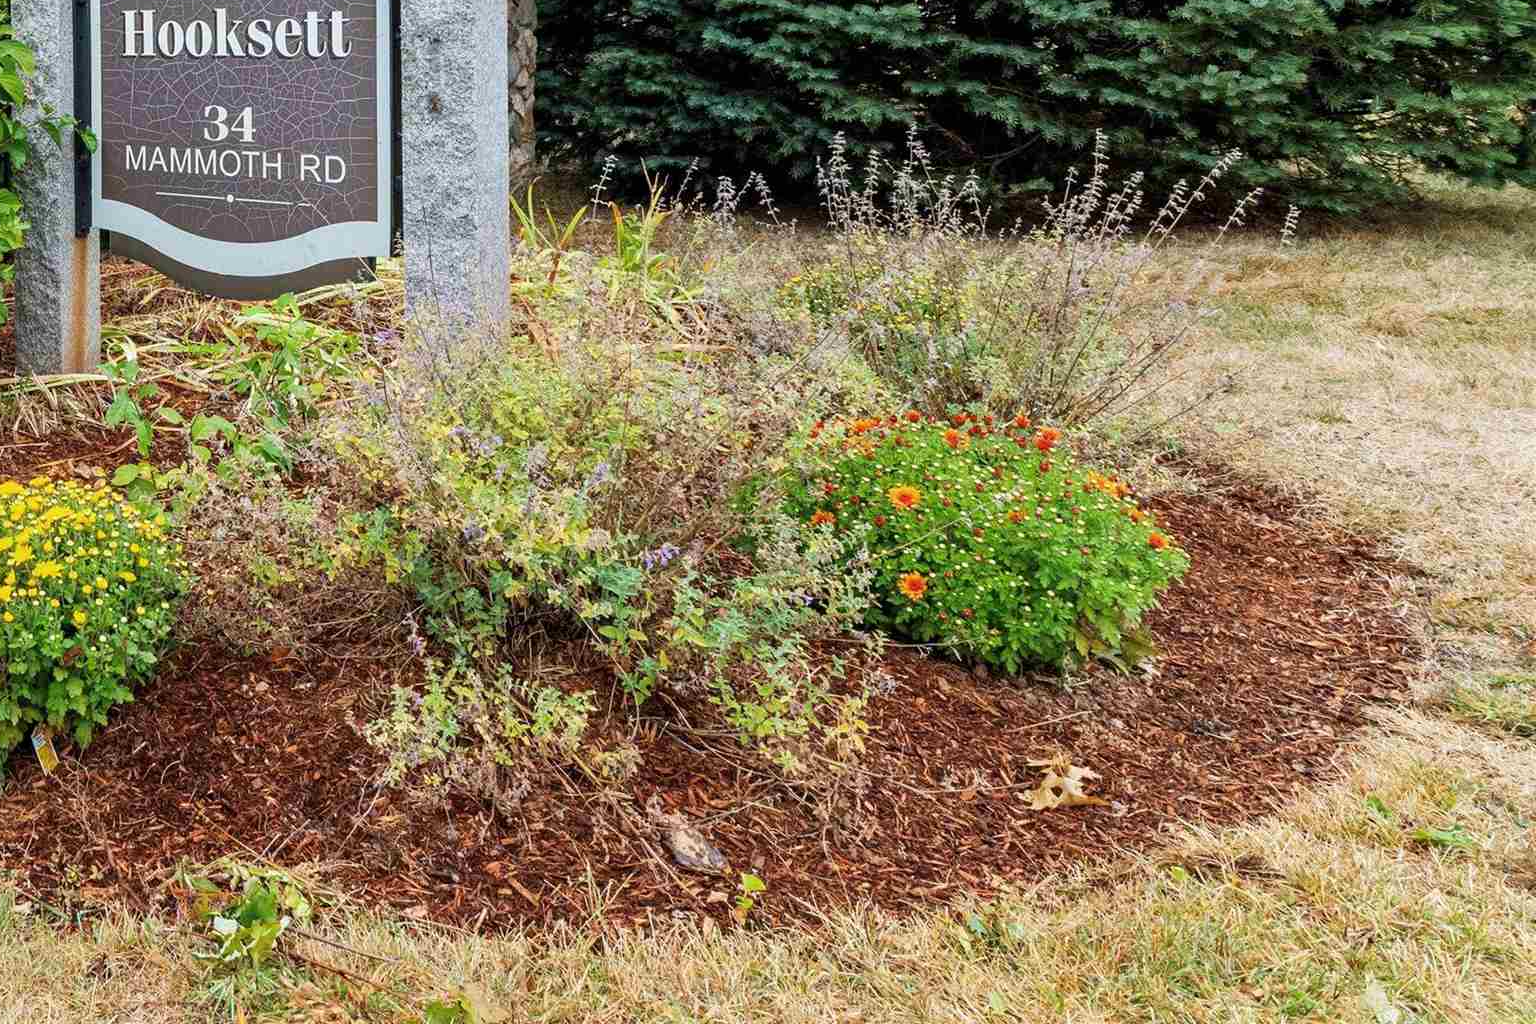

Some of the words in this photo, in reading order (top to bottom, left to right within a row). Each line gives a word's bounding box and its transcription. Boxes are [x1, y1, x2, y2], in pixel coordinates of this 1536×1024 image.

[122, 7, 351, 58] Hooksett
[203, 105, 256, 142] 34
[125, 144, 282, 180] MAMMOTH
[300, 153, 346, 184] RD
